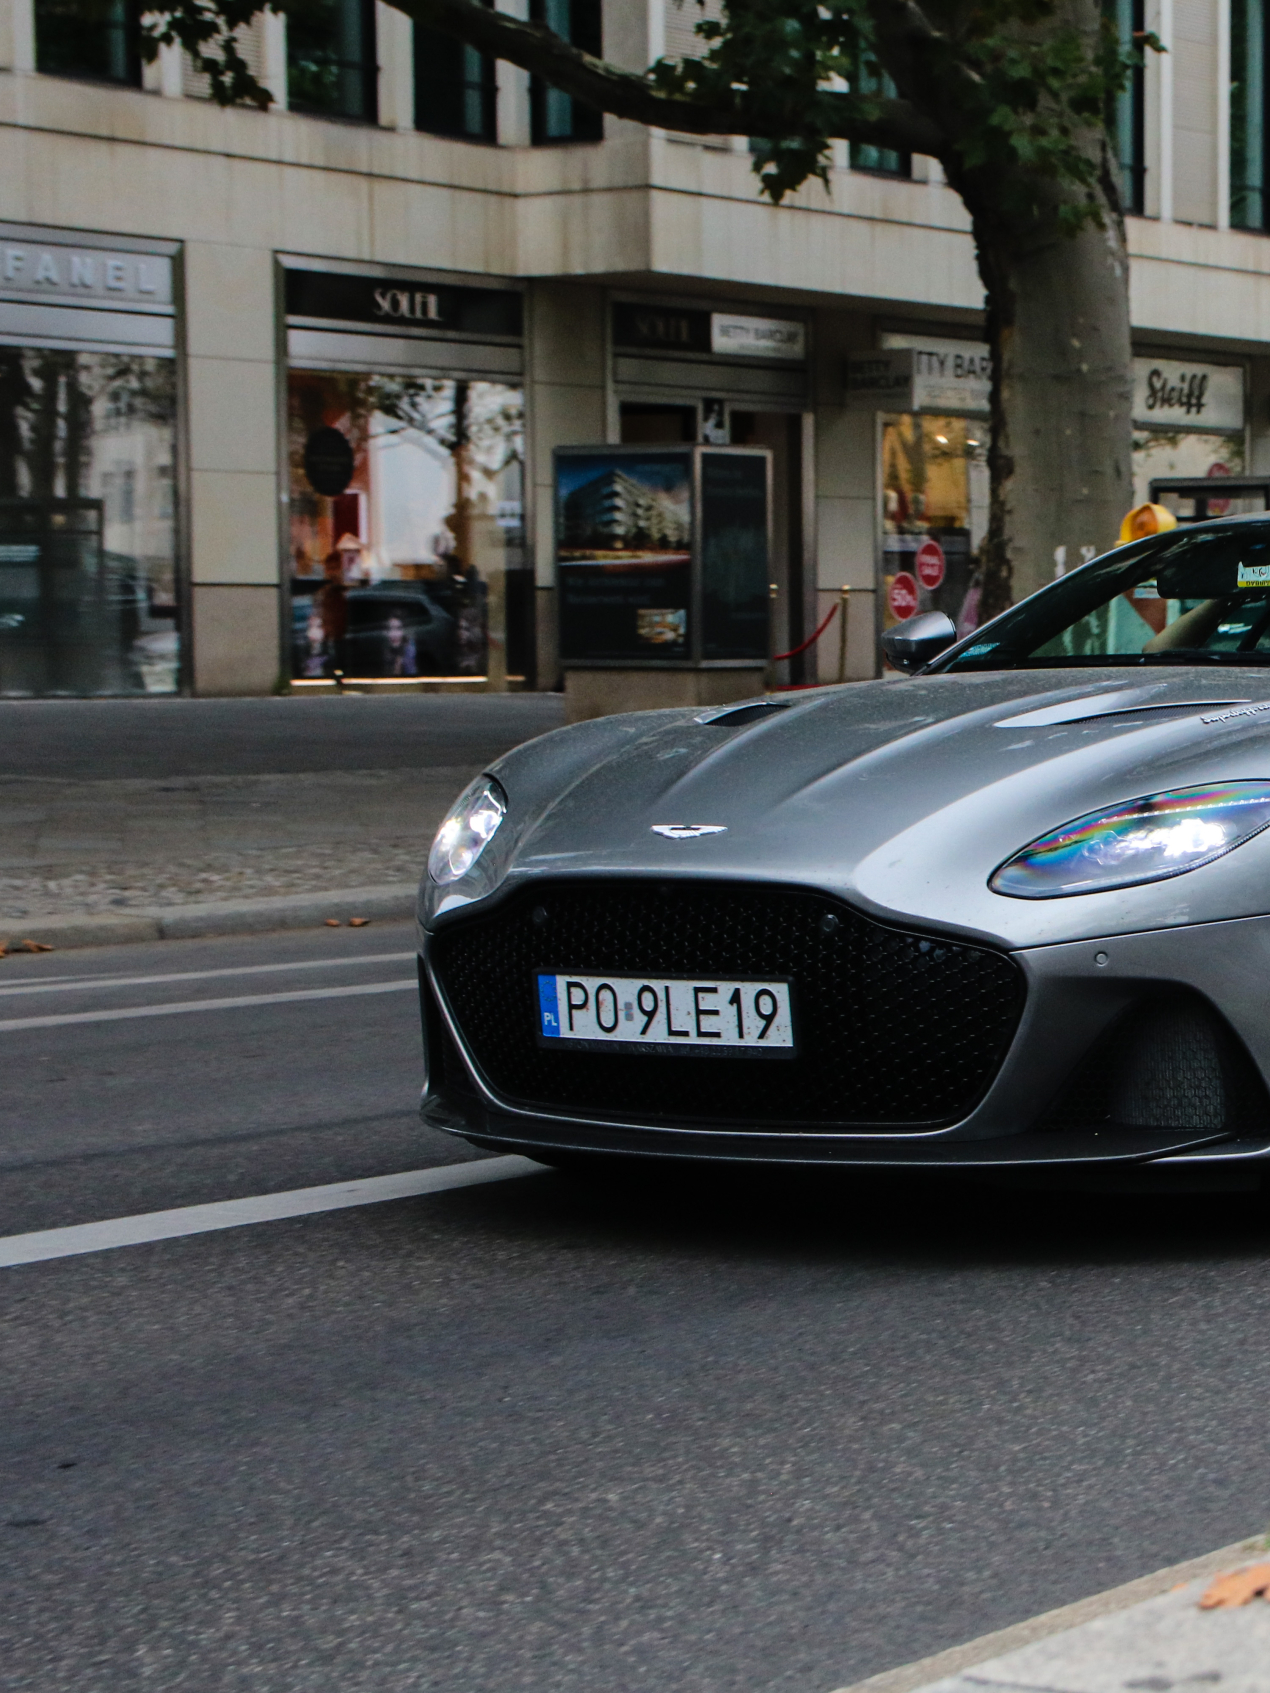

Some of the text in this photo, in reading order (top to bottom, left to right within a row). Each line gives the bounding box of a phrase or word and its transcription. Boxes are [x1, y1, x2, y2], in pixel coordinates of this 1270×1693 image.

[4, 250, 156, 293] FANEL
[1146, 368, 1208, 415] Steiff
[543, 1012, 558, 1026] PL
